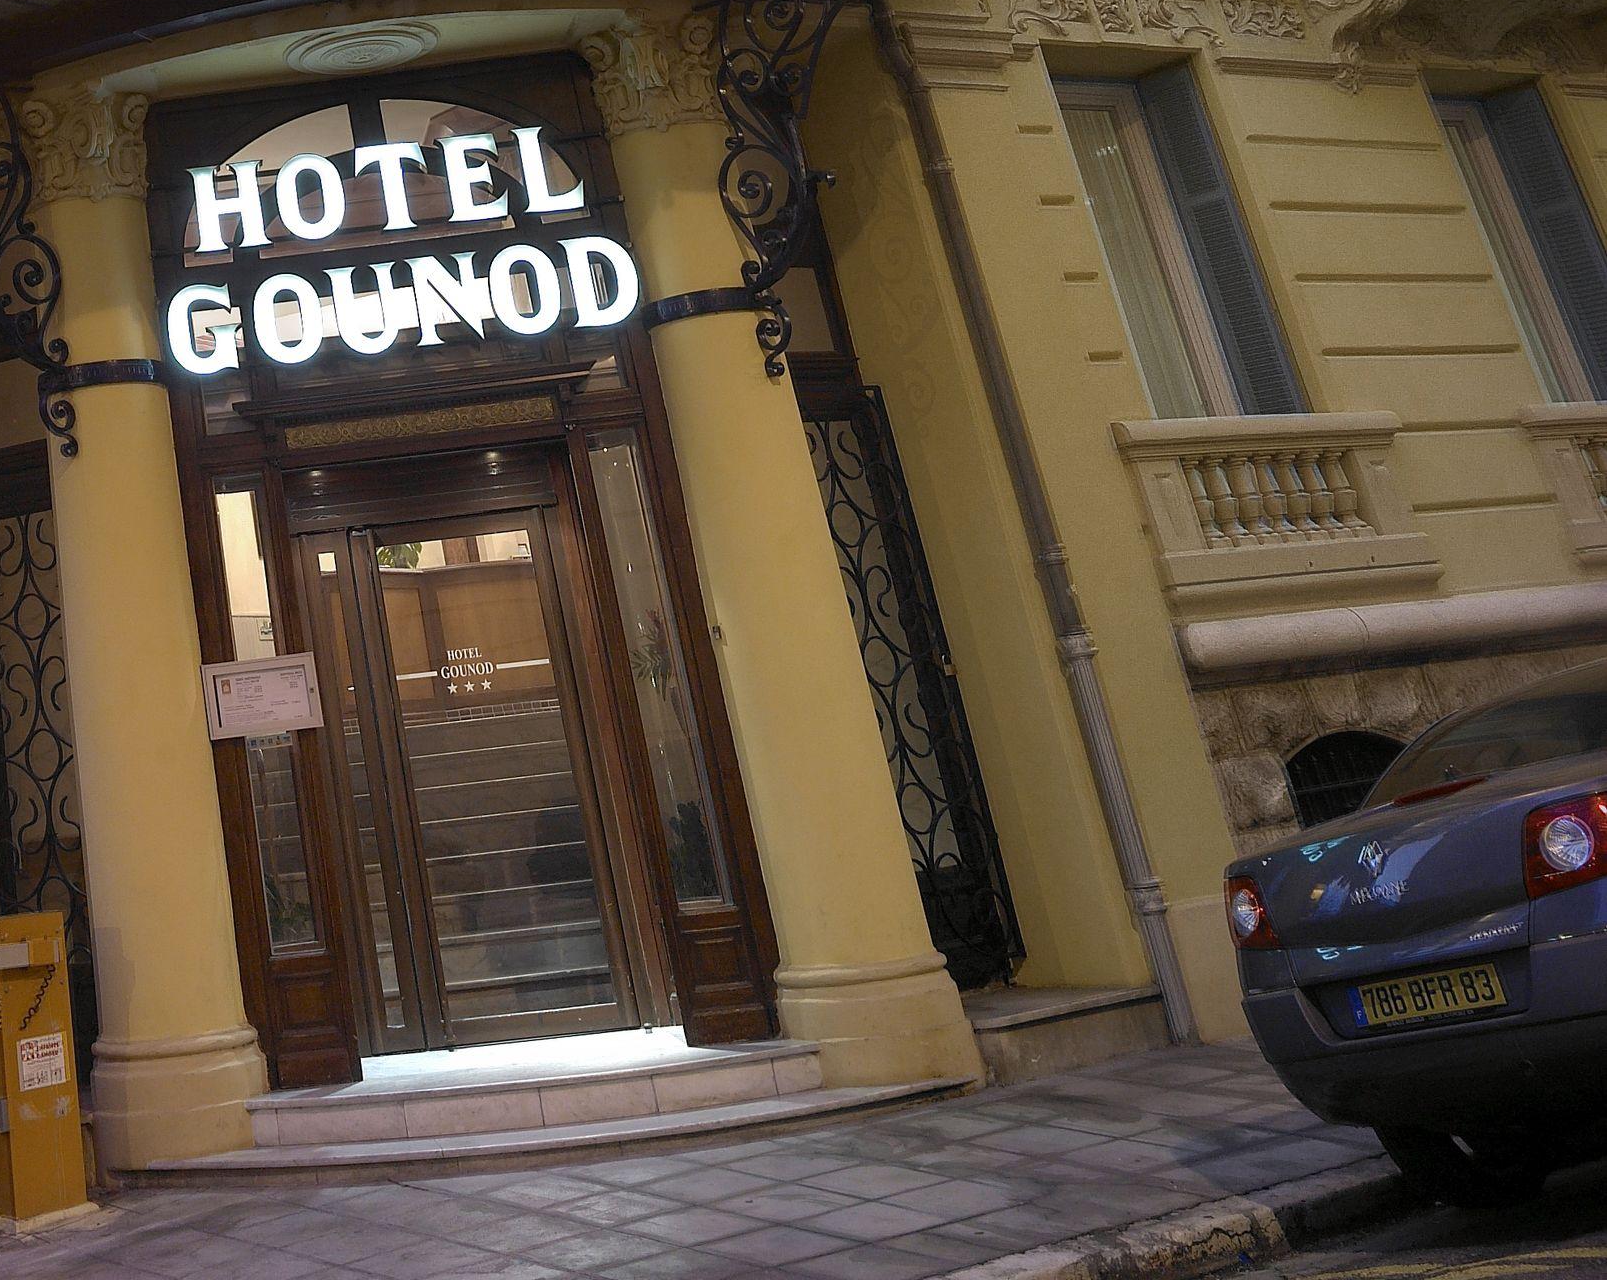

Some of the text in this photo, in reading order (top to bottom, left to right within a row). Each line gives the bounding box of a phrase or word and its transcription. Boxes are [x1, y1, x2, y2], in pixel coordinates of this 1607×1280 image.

[186, 127, 585, 253] HOTEL
[167, 236, 641, 375] GOUNOD
[440, 661, 494, 679] GOUNOD
[447, 647, 482, 661] HOTEL
[1362, 983, 1408, 1019] 786
[1407, 974, 1459, 1012] BFR
[1458, 969, 1496, 1004] 83
